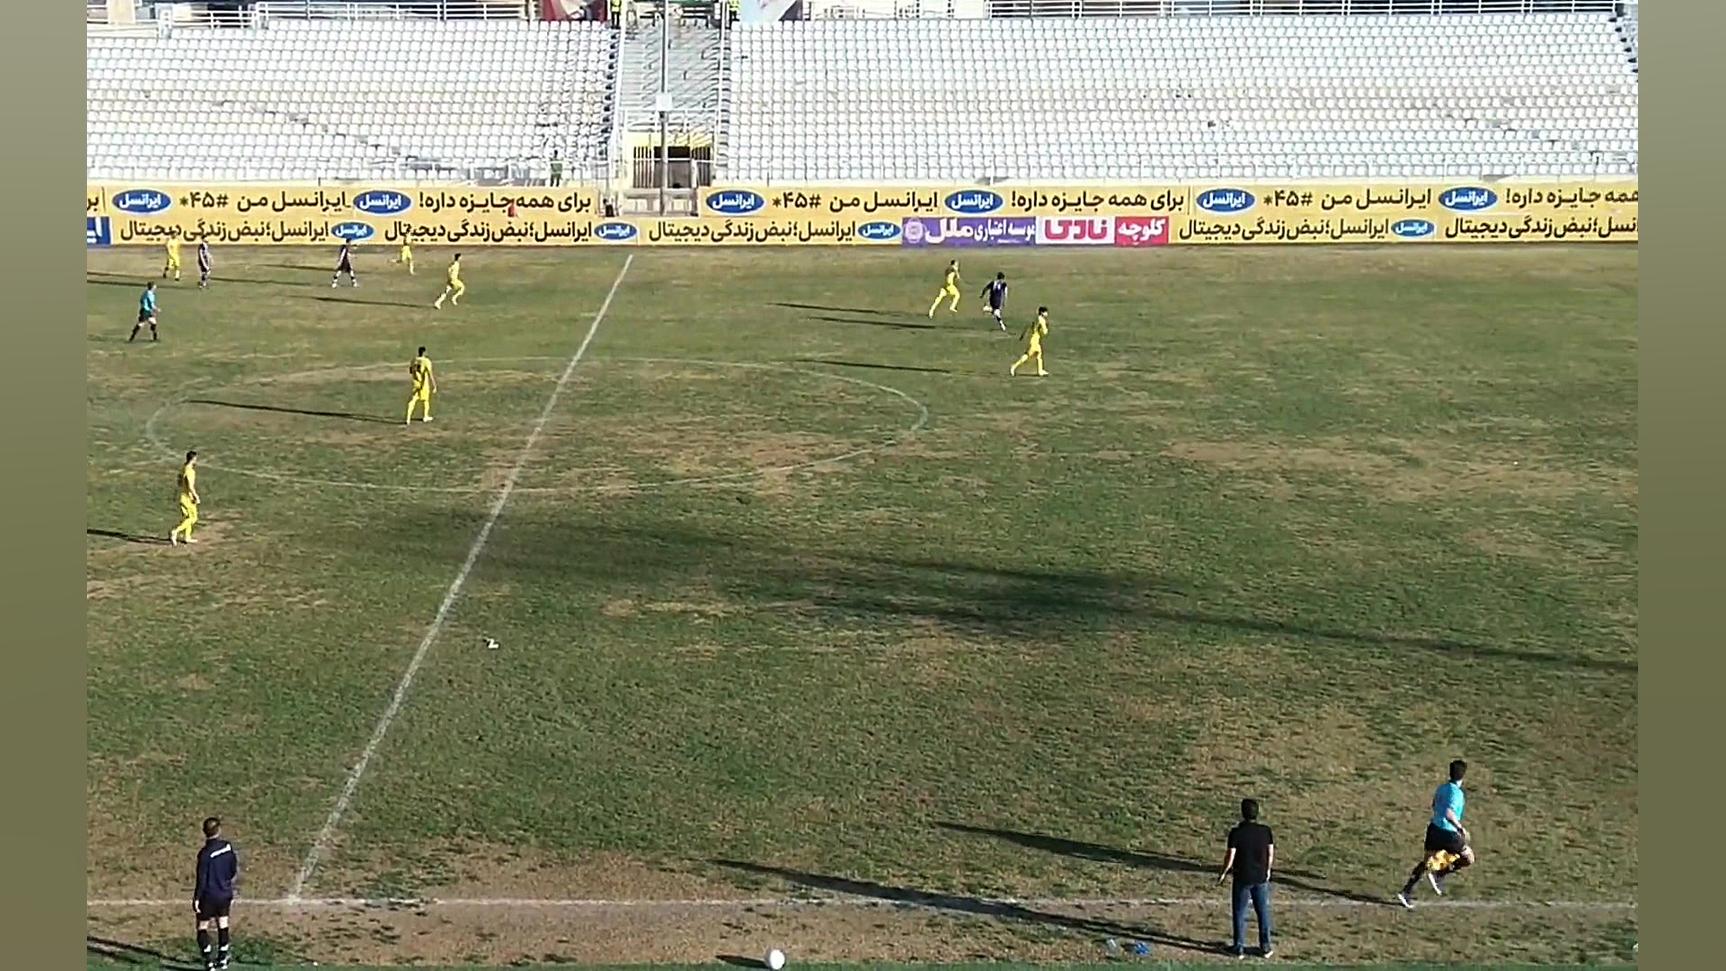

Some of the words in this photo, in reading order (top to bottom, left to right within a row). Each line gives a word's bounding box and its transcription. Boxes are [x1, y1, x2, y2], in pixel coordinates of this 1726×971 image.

[119, 193, 162, 208] ایرانسل
[237, 196, 268, 213] من
[271, 190, 346, 213] ایرانسل
[359, 194, 402, 209] ایرانسل
[419, 191, 456, 213] داره!
[459, 192, 514, 214] جایزه
[516, 195, 554, 208] همه
[557, 192, 591, 213] برای
[712, 193, 755, 209] ایرانسل
[829, 196, 860, 213] من
[863, 191, 938, 213] ایرانسل
[951, 193, 994, 208] ایرانسل
[1011, 190, 1048, 212] داره!
[1051, 191, 1105, 212] جایزه
[1108, 194, 1147, 207] همه
[1150, 190, 1184, 212] برای
[1202, 191, 1246, 207] ایرانسل
[1321, 194, 1353, 211] من
[1356, 188, 1431, 210] ایرانسل
[1444, 189, 1488, 205] ایرانسل
[1506, 188, 1543, 209] داره!
[1546, 187, 1601, 209] جایزه
[120, 220, 182, 242] دیجیتال
[183, 221, 227, 242] زندگی
[335, 224, 368, 237] ایرانسل
[447, 218, 491, 243] زندگی
[599, 224, 631, 237] ایرانسل
[649, 221, 710, 242] دیجیتال
[710, 219, 754, 243] زندگی
[862, 224, 895, 237] ایرانسل
[924, 218, 974, 243] ملل
[1118, 217, 1166, 245] کلوچه
[1179, 219, 1241, 241] دیجیتال
[1241, 219, 1286, 241] زندگی
[1394, 222, 1429, 236] ایرانسل
[1445, 217, 1508, 239] دیجیتال
[1508, 215, 1553, 239] زندگی
